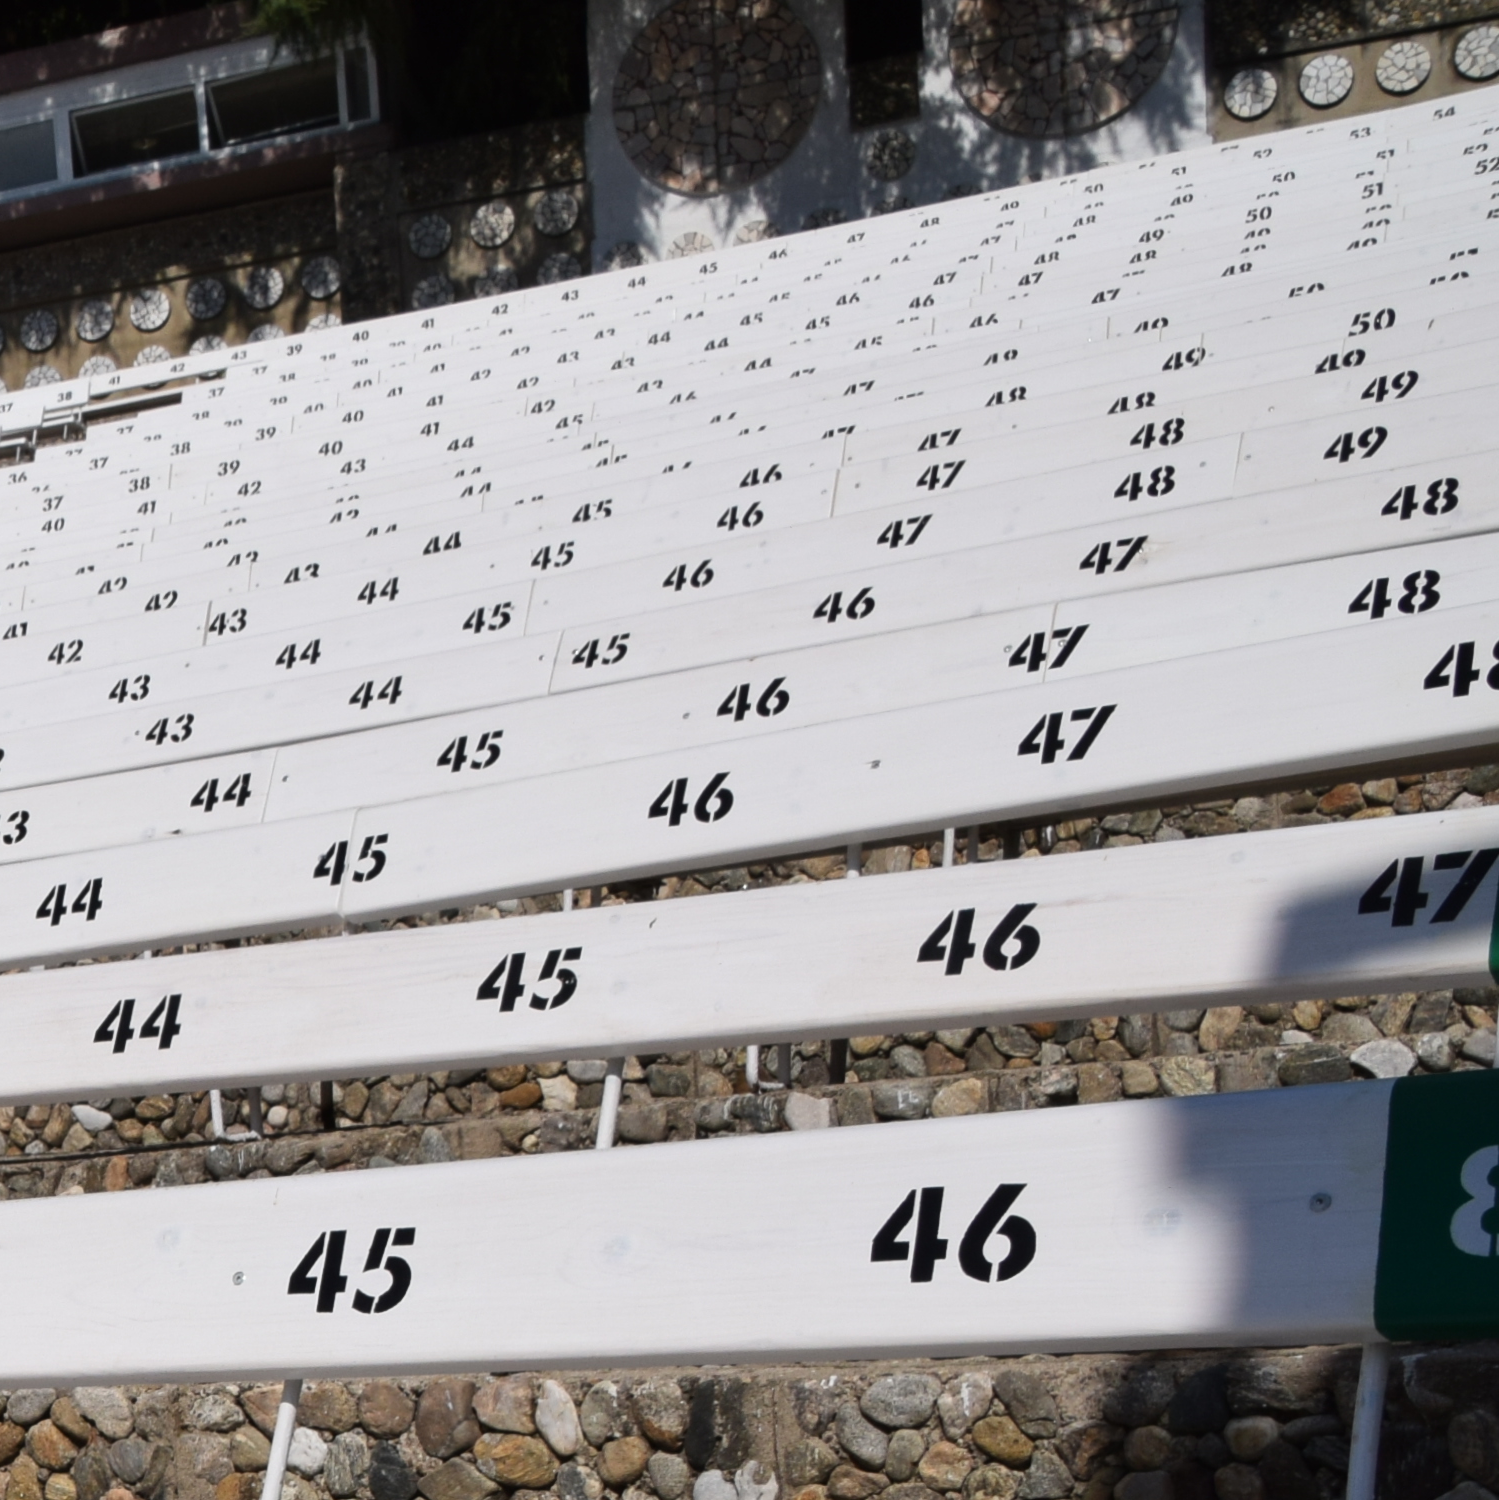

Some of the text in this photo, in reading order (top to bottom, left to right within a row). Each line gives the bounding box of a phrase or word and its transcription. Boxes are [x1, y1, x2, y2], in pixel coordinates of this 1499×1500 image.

[1352, 309, 1395, 334] 50
[276, 427, 1387, 669] 44 45 46 47 48 49
[717, 371, 1418, 530] 46 47 48 49
[146, 478, 1458, 745] 43 44 45 46 47 48
[191, 773, 251, 812] 44
[437, 733, 500, 772] 45
[717, 677, 789, 721] 46
[1009, 625, 1089, 672] 47
[1348, 570, 1440, 619] 48
[36, 878, 102, 926] 44
[314, 836, 386, 885] 45
[649, 772, 733, 826] 46
[1018, 705, 1117, 764] 47
[1424, 641, 1499, 697] 4
[94, 994, 181, 1053] 44
[477, 947, 582, 1012] 45
[917, 903, 1040, 975] 46
[1358, 848, 1499, 927] 47
[288, 1228, 415, 1313] 45
[871, 1184, 1036, 1282] 46
